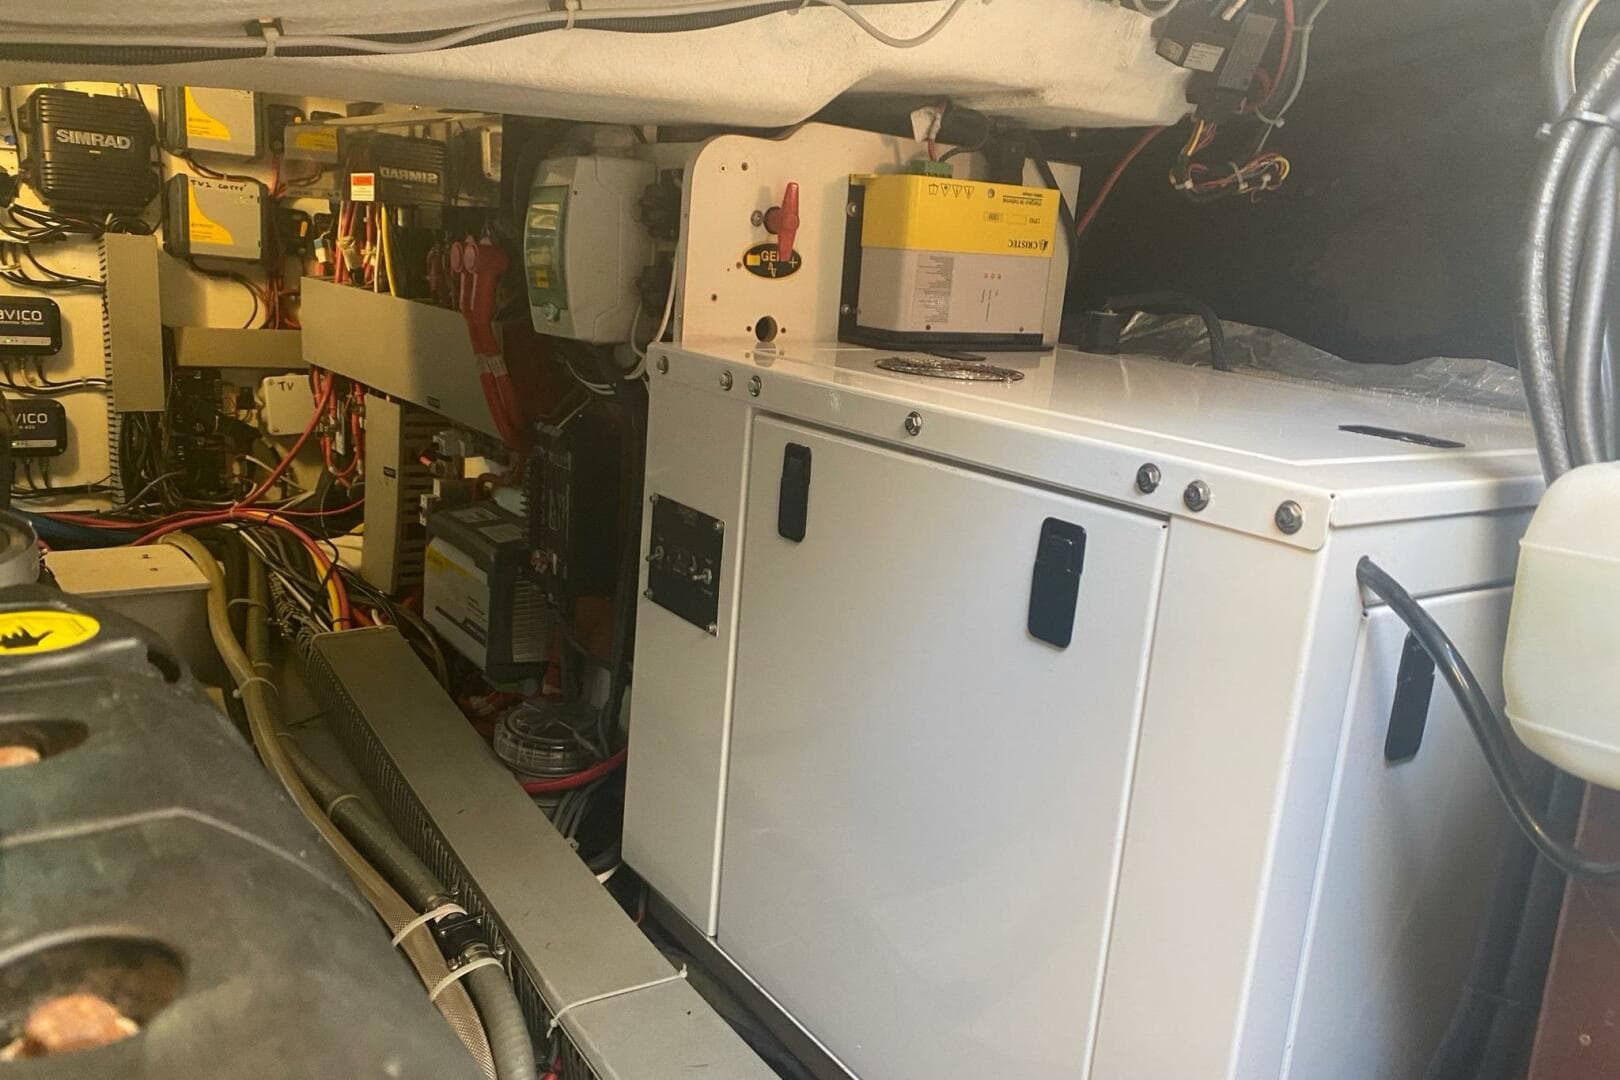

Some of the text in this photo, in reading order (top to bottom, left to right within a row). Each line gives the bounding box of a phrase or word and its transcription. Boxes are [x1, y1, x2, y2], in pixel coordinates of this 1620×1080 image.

[56, 128, 132, 150] SIMRAD
[1007, 239, 1038, 249] CRISTEC
[277, 381, 294, 391] TV
